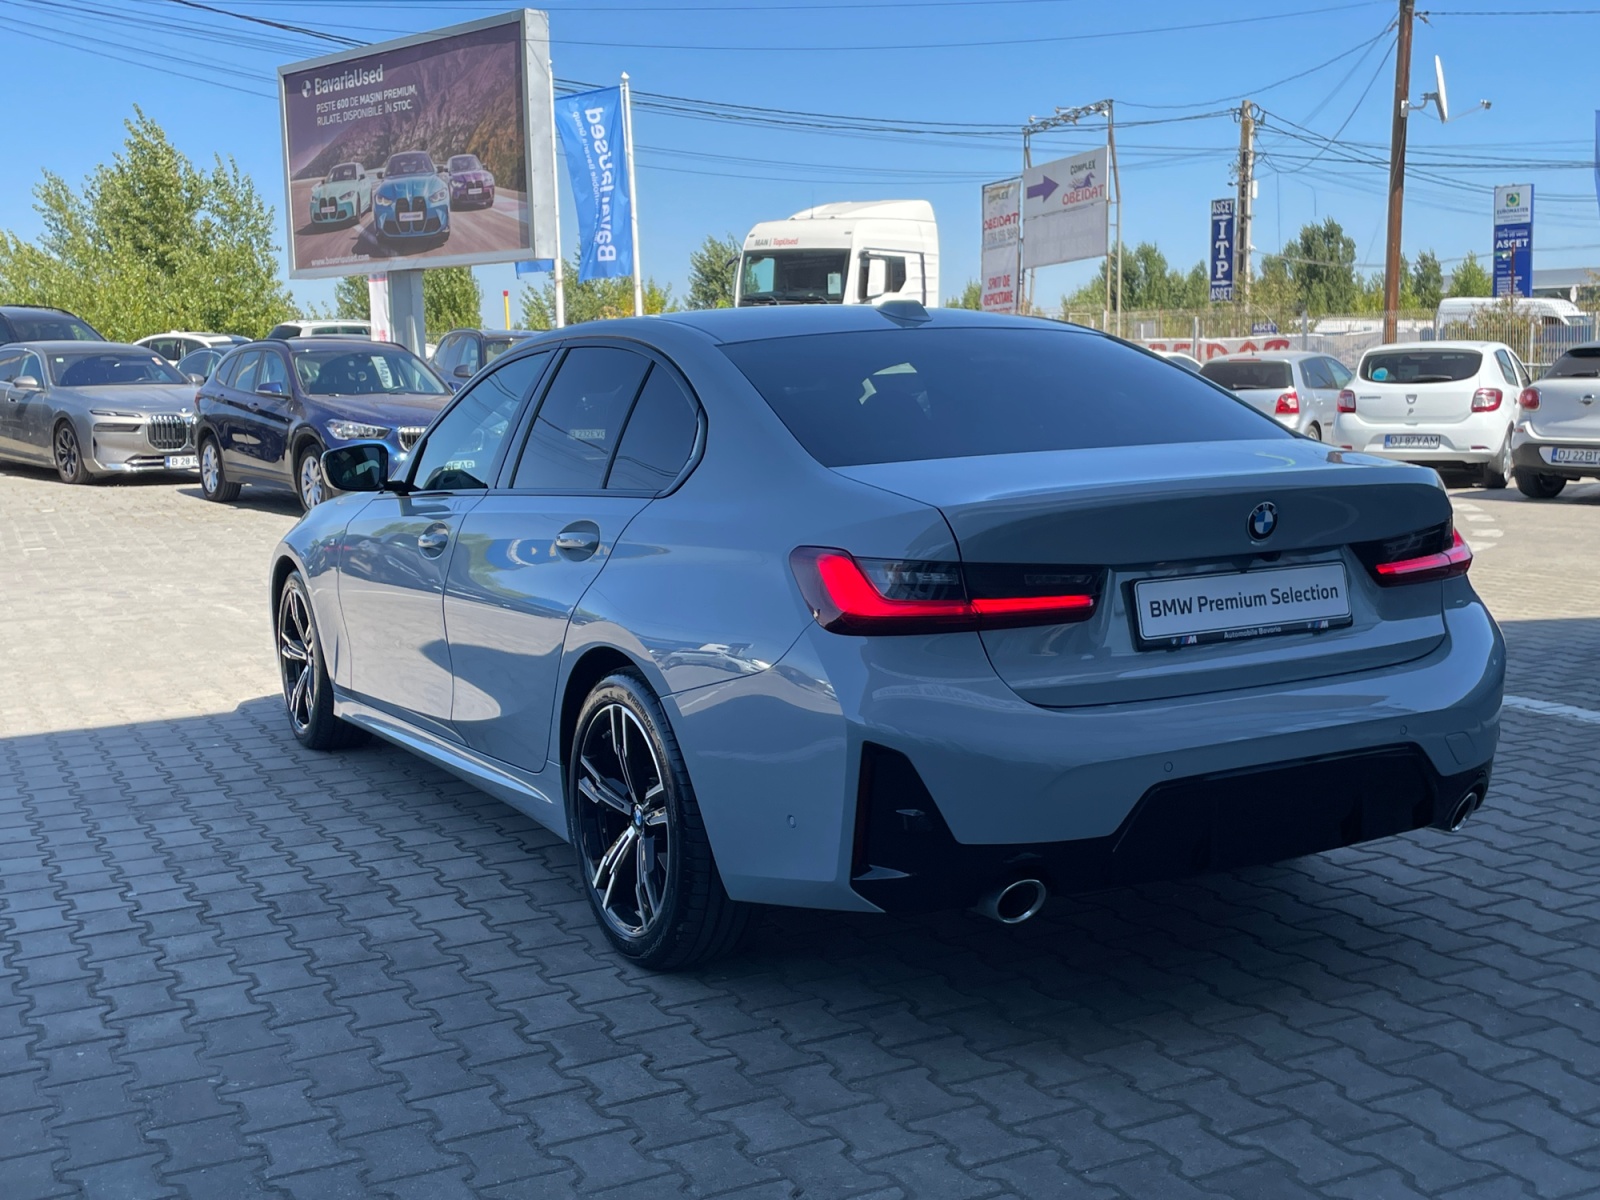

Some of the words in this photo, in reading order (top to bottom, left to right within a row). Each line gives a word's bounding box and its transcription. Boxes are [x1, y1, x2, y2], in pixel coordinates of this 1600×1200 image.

[315, 64, 383, 95] BavariaUsed
[316, 100, 336, 113] PESTE
[337, 98, 349, 110] 600
[350, 97, 359, 107] DE
[383, 84, 417, 100] PREMIUM,
[317, 113, 342, 126] RULATE,
[343, 104, 382, 122] DISPONIBILE
[1070, 159, 1096, 175] COMPLEX
[1062, 184, 1105, 206] OBEIDAT
[1212, 201, 1233, 214] ASCET
[983, 212, 1019, 231] OBEIDAT
[754, 239, 768, 247] MAN
[773, 238, 798, 247] TopUsed
[1215, 221, 1229, 279] ITP
[1496, 238, 1529, 249] ASCET
[1211, 287, 1232, 300] ASCET
[1390, 436, 1403, 446] DJ
[172, 457, 178, 465] B
[1558, 450, 1570, 460] DJ
[1573, 450, 1600, 461] 22BT
[1149, 596, 1193, 618] BMW
[1197, 591, 1267, 613] Premium
[1270, 583, 1339, 605] Selection
[1224, 628, 1258, 639] Automobile
[1258, 626, 1282, 635] Bavaria
[630, 695, 655, 733] Hankook
